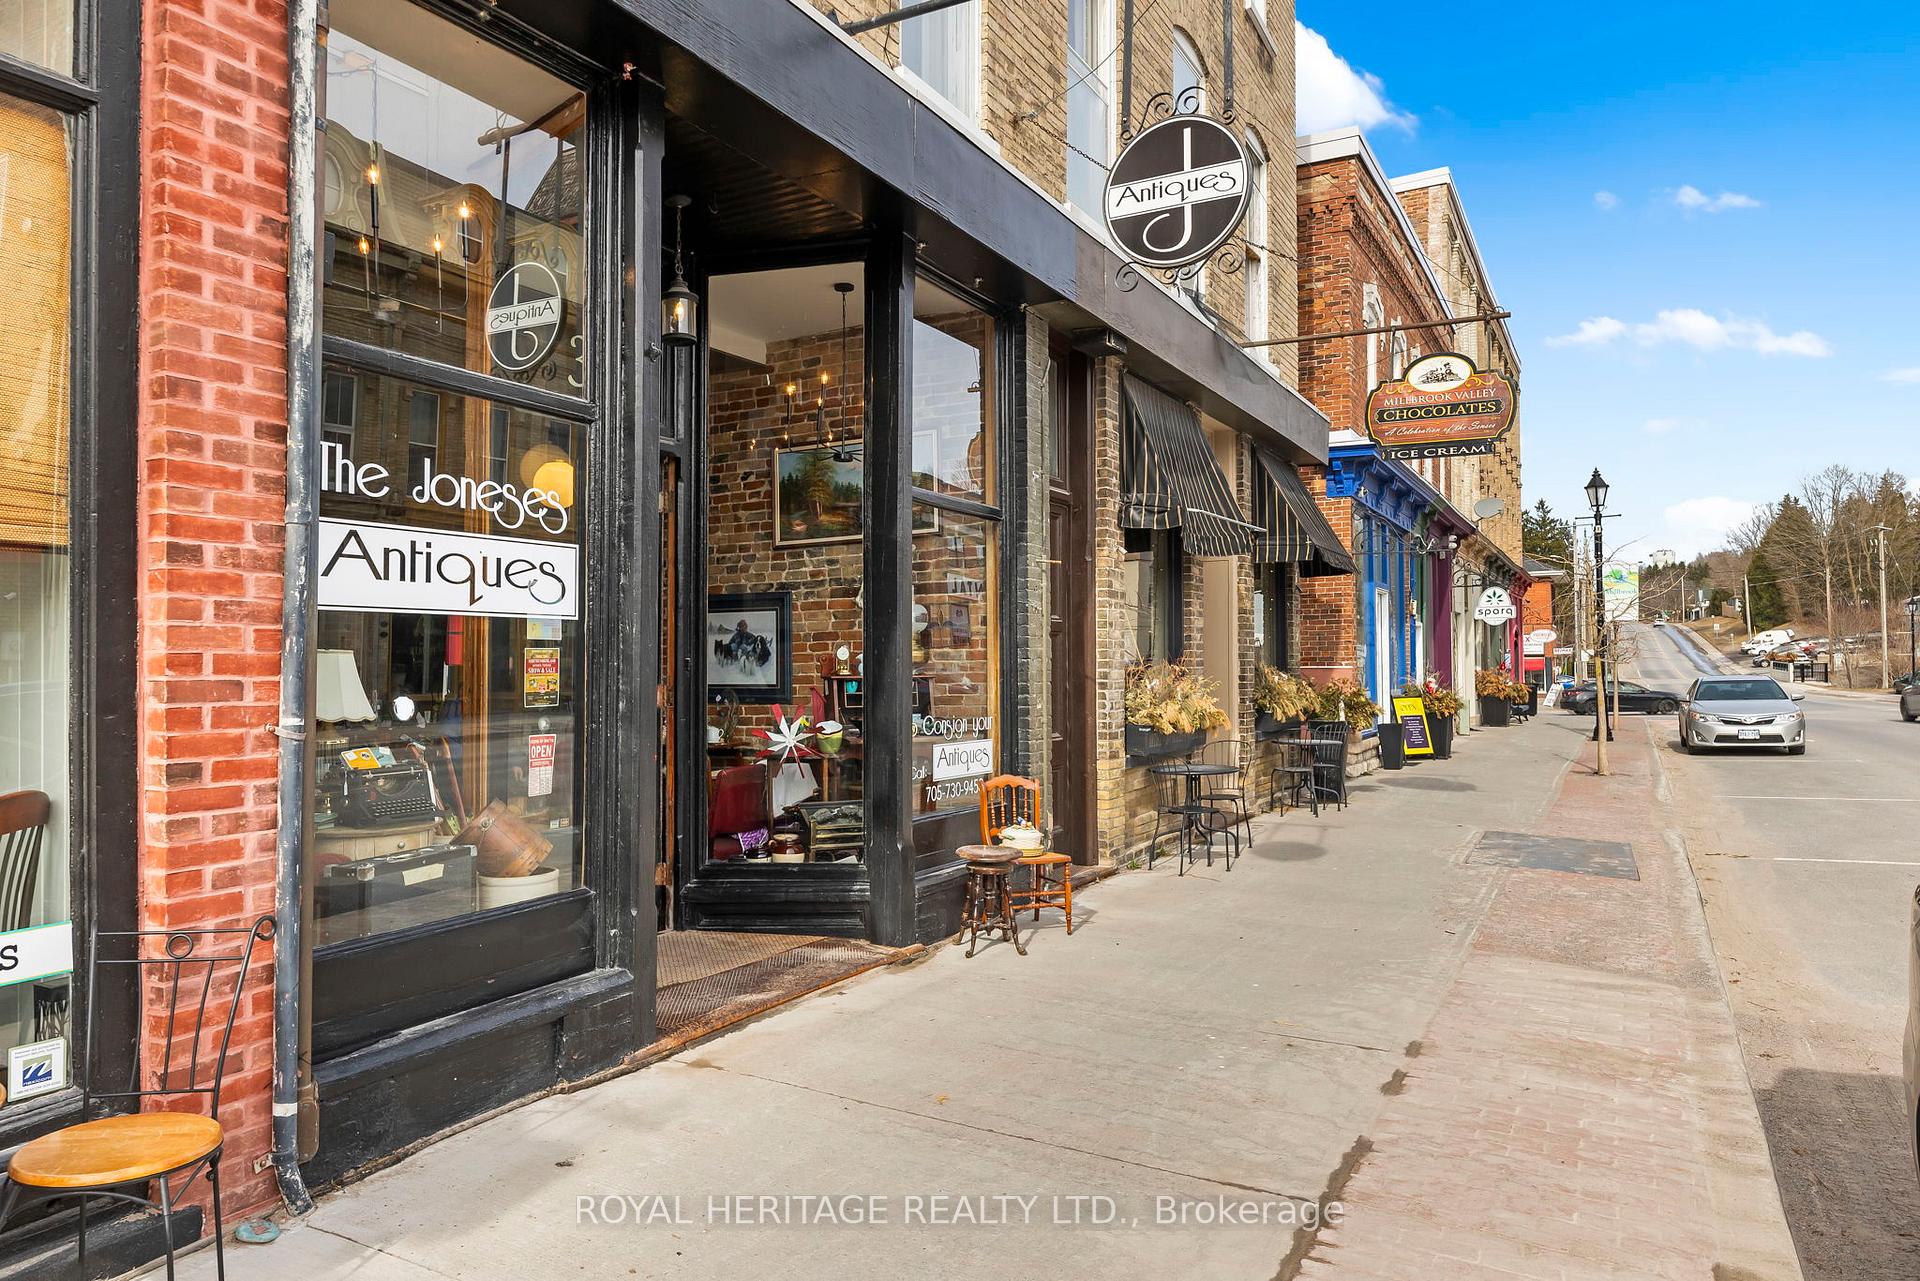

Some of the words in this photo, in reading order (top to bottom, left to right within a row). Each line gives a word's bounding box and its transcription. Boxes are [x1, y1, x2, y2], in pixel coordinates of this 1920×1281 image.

[1116, 171, 1236, 207] Antiques
[1384, 391, 1452, 407] MILLBROOK
[1454, 388, 1497, 400] VALLEY
[1383, 401, 1496, 421] CHOCOLATES
[1385, 427, 1395, 436] A
[1397, 425, 1440, 436] Celebration
[1443, 423, 1454, 434] of
[1454, 422, 1468, 432] the
[1390, 449, 1419, 459] ICE
[1423, 445, 1486, 457] CREAM
[319, 441, 390, 498] The
[412, 457, 568, 535] Joneses
[320, 529, 566, 607] Antiques
[1477, 607, 1513, 617] sparq
[923, 715, 967, 740] Consign
[972, 716, 993, 737] your
[531, 744, 552, 759] OPEN
[936, 747, 990, 772] Antiques
